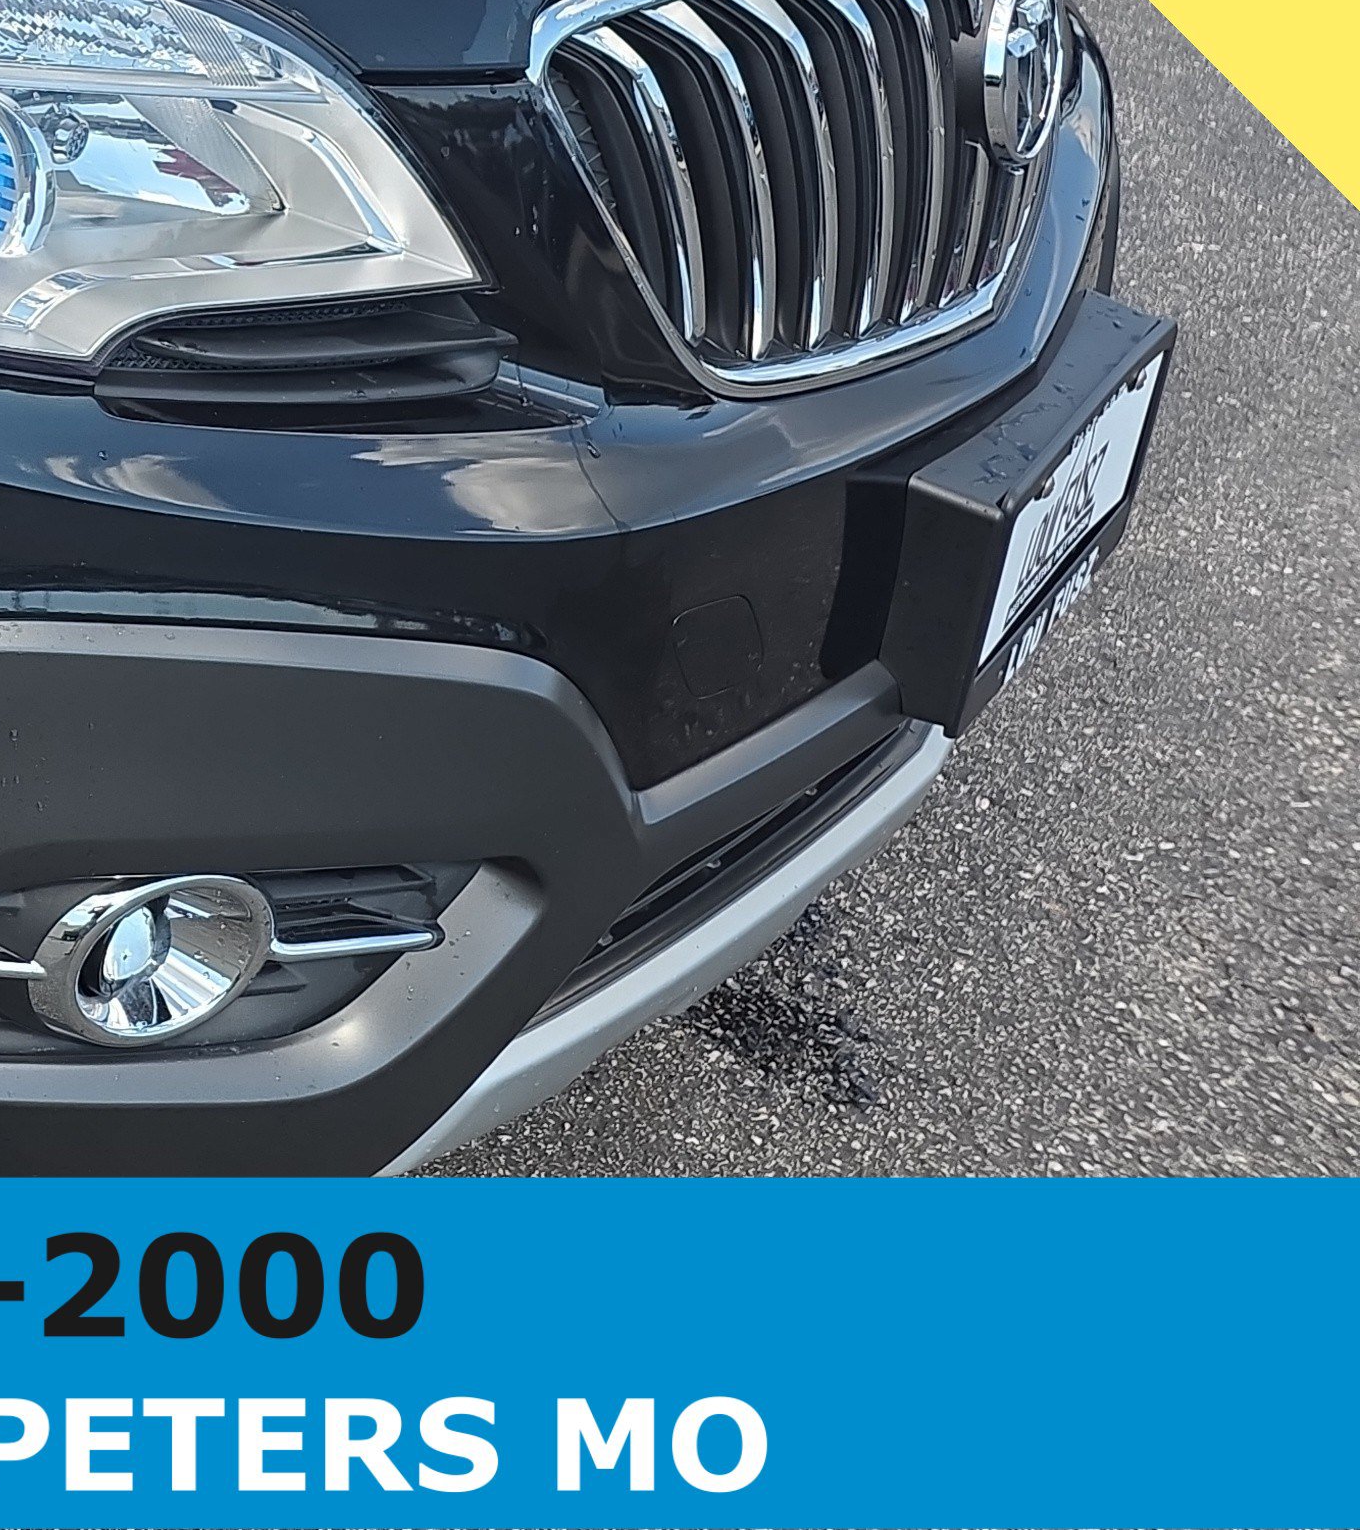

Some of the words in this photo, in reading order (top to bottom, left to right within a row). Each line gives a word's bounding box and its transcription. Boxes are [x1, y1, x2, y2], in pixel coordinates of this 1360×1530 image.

[1015, 491, 1063, 594] LOU
[1053, 437, 1110, 547] FUSZ
[1002, 602, 1049, 682] LOU
[1045, 540, 1101, 633] FUSZ
